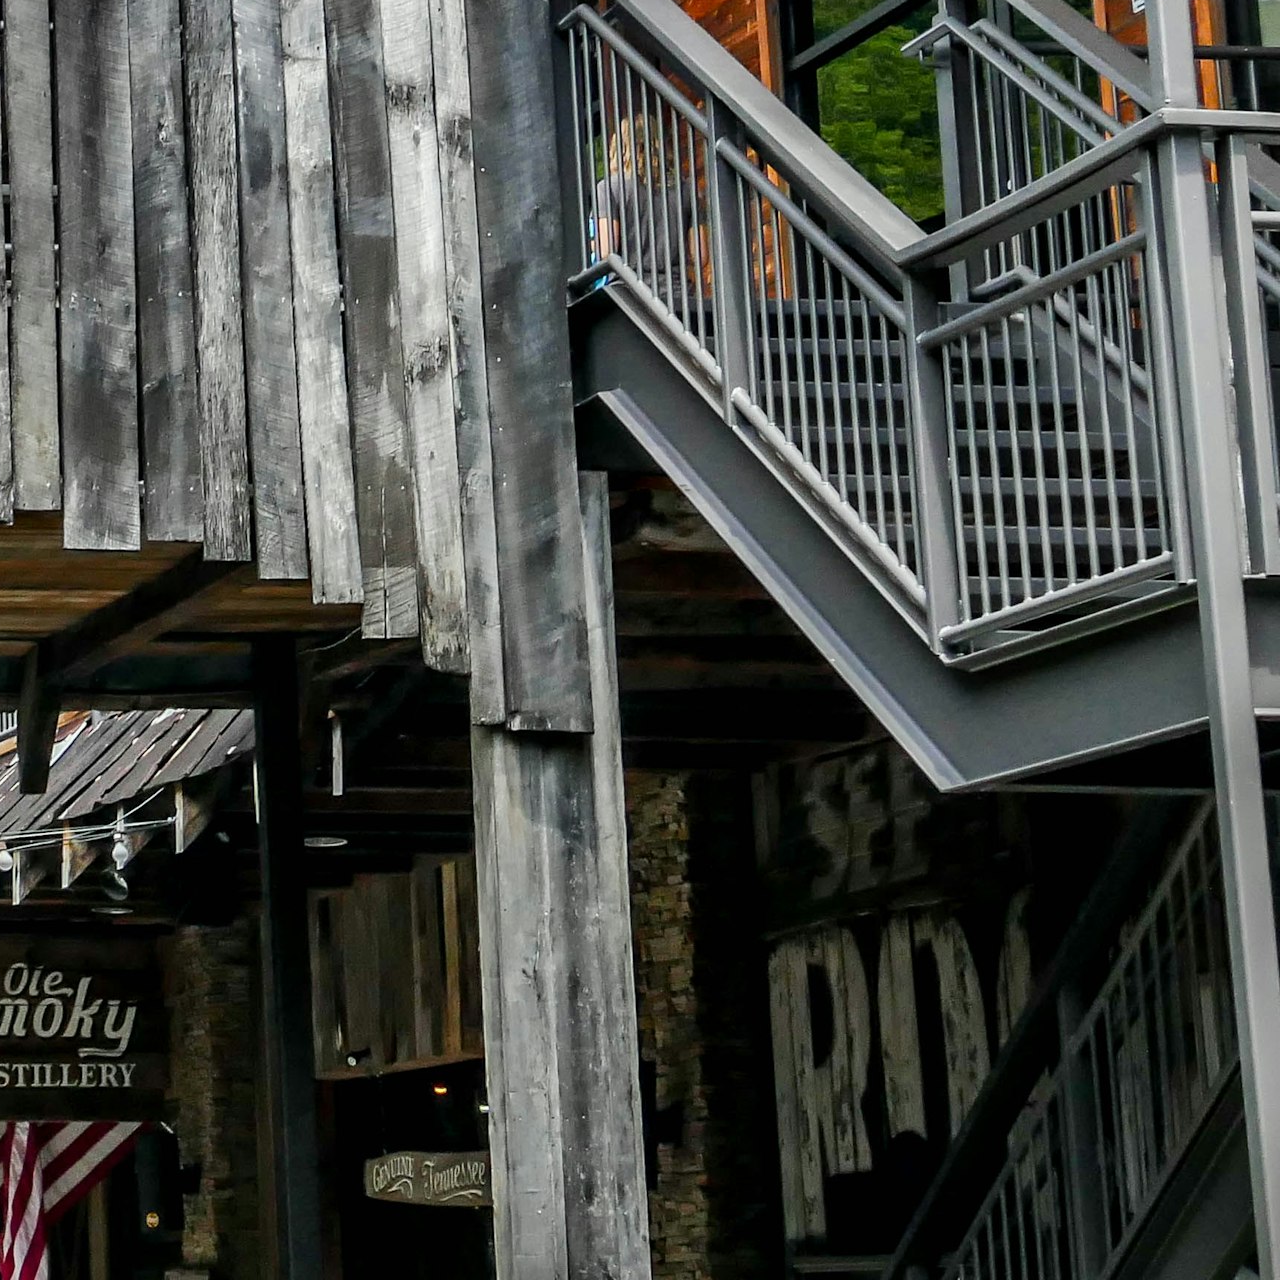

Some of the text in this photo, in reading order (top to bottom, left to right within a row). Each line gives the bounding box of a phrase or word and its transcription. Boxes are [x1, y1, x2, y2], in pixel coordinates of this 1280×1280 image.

[4, 962, 74, 997] Ole
[372, 1156, 486, 1200] GENUINE Tennessee
